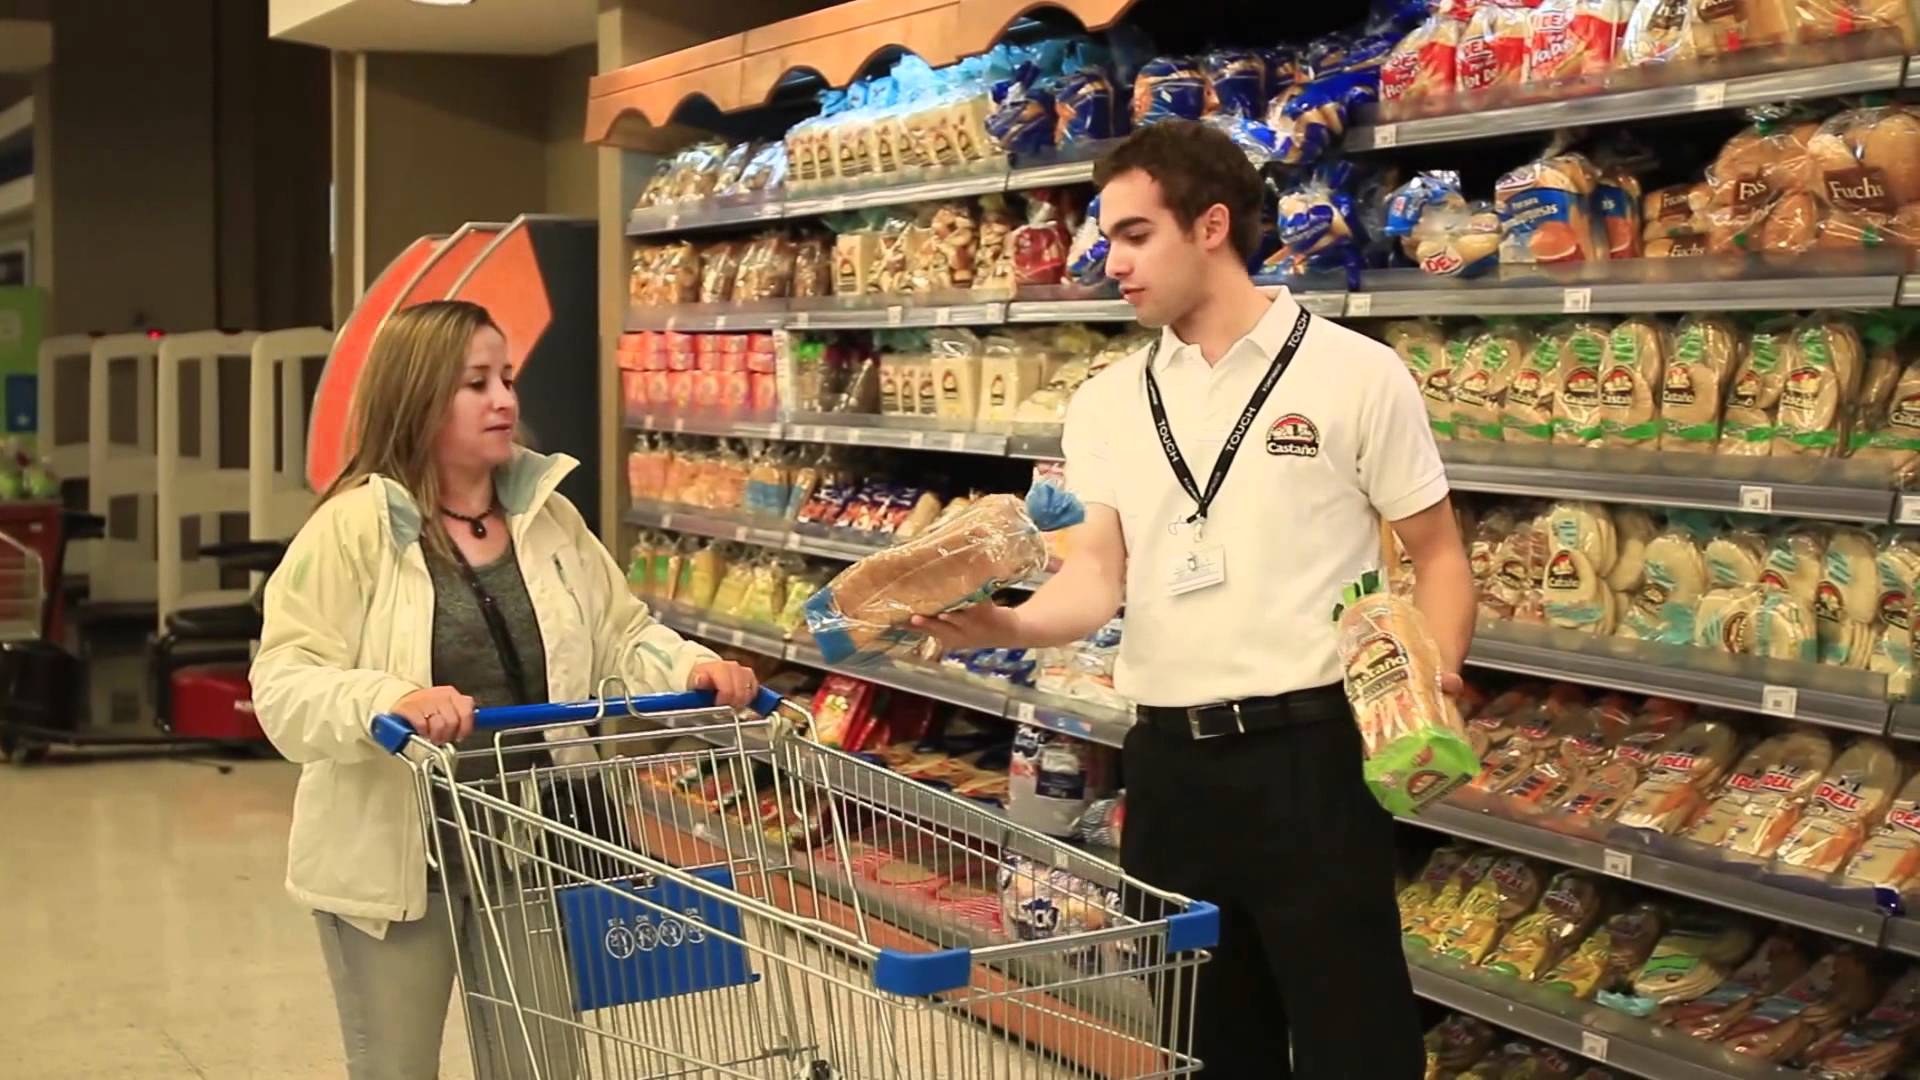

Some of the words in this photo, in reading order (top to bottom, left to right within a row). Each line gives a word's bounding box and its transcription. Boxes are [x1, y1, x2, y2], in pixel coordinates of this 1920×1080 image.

[1829, 177, 1884, 199] Fuchs
[1286, 312, 1309, 348] TOUCH
[1157, 418, 1180, 463] TOUCH
[1225, 406, 1257, 452] TOUCH
[1267, 442, 1318, 455] Castaño
